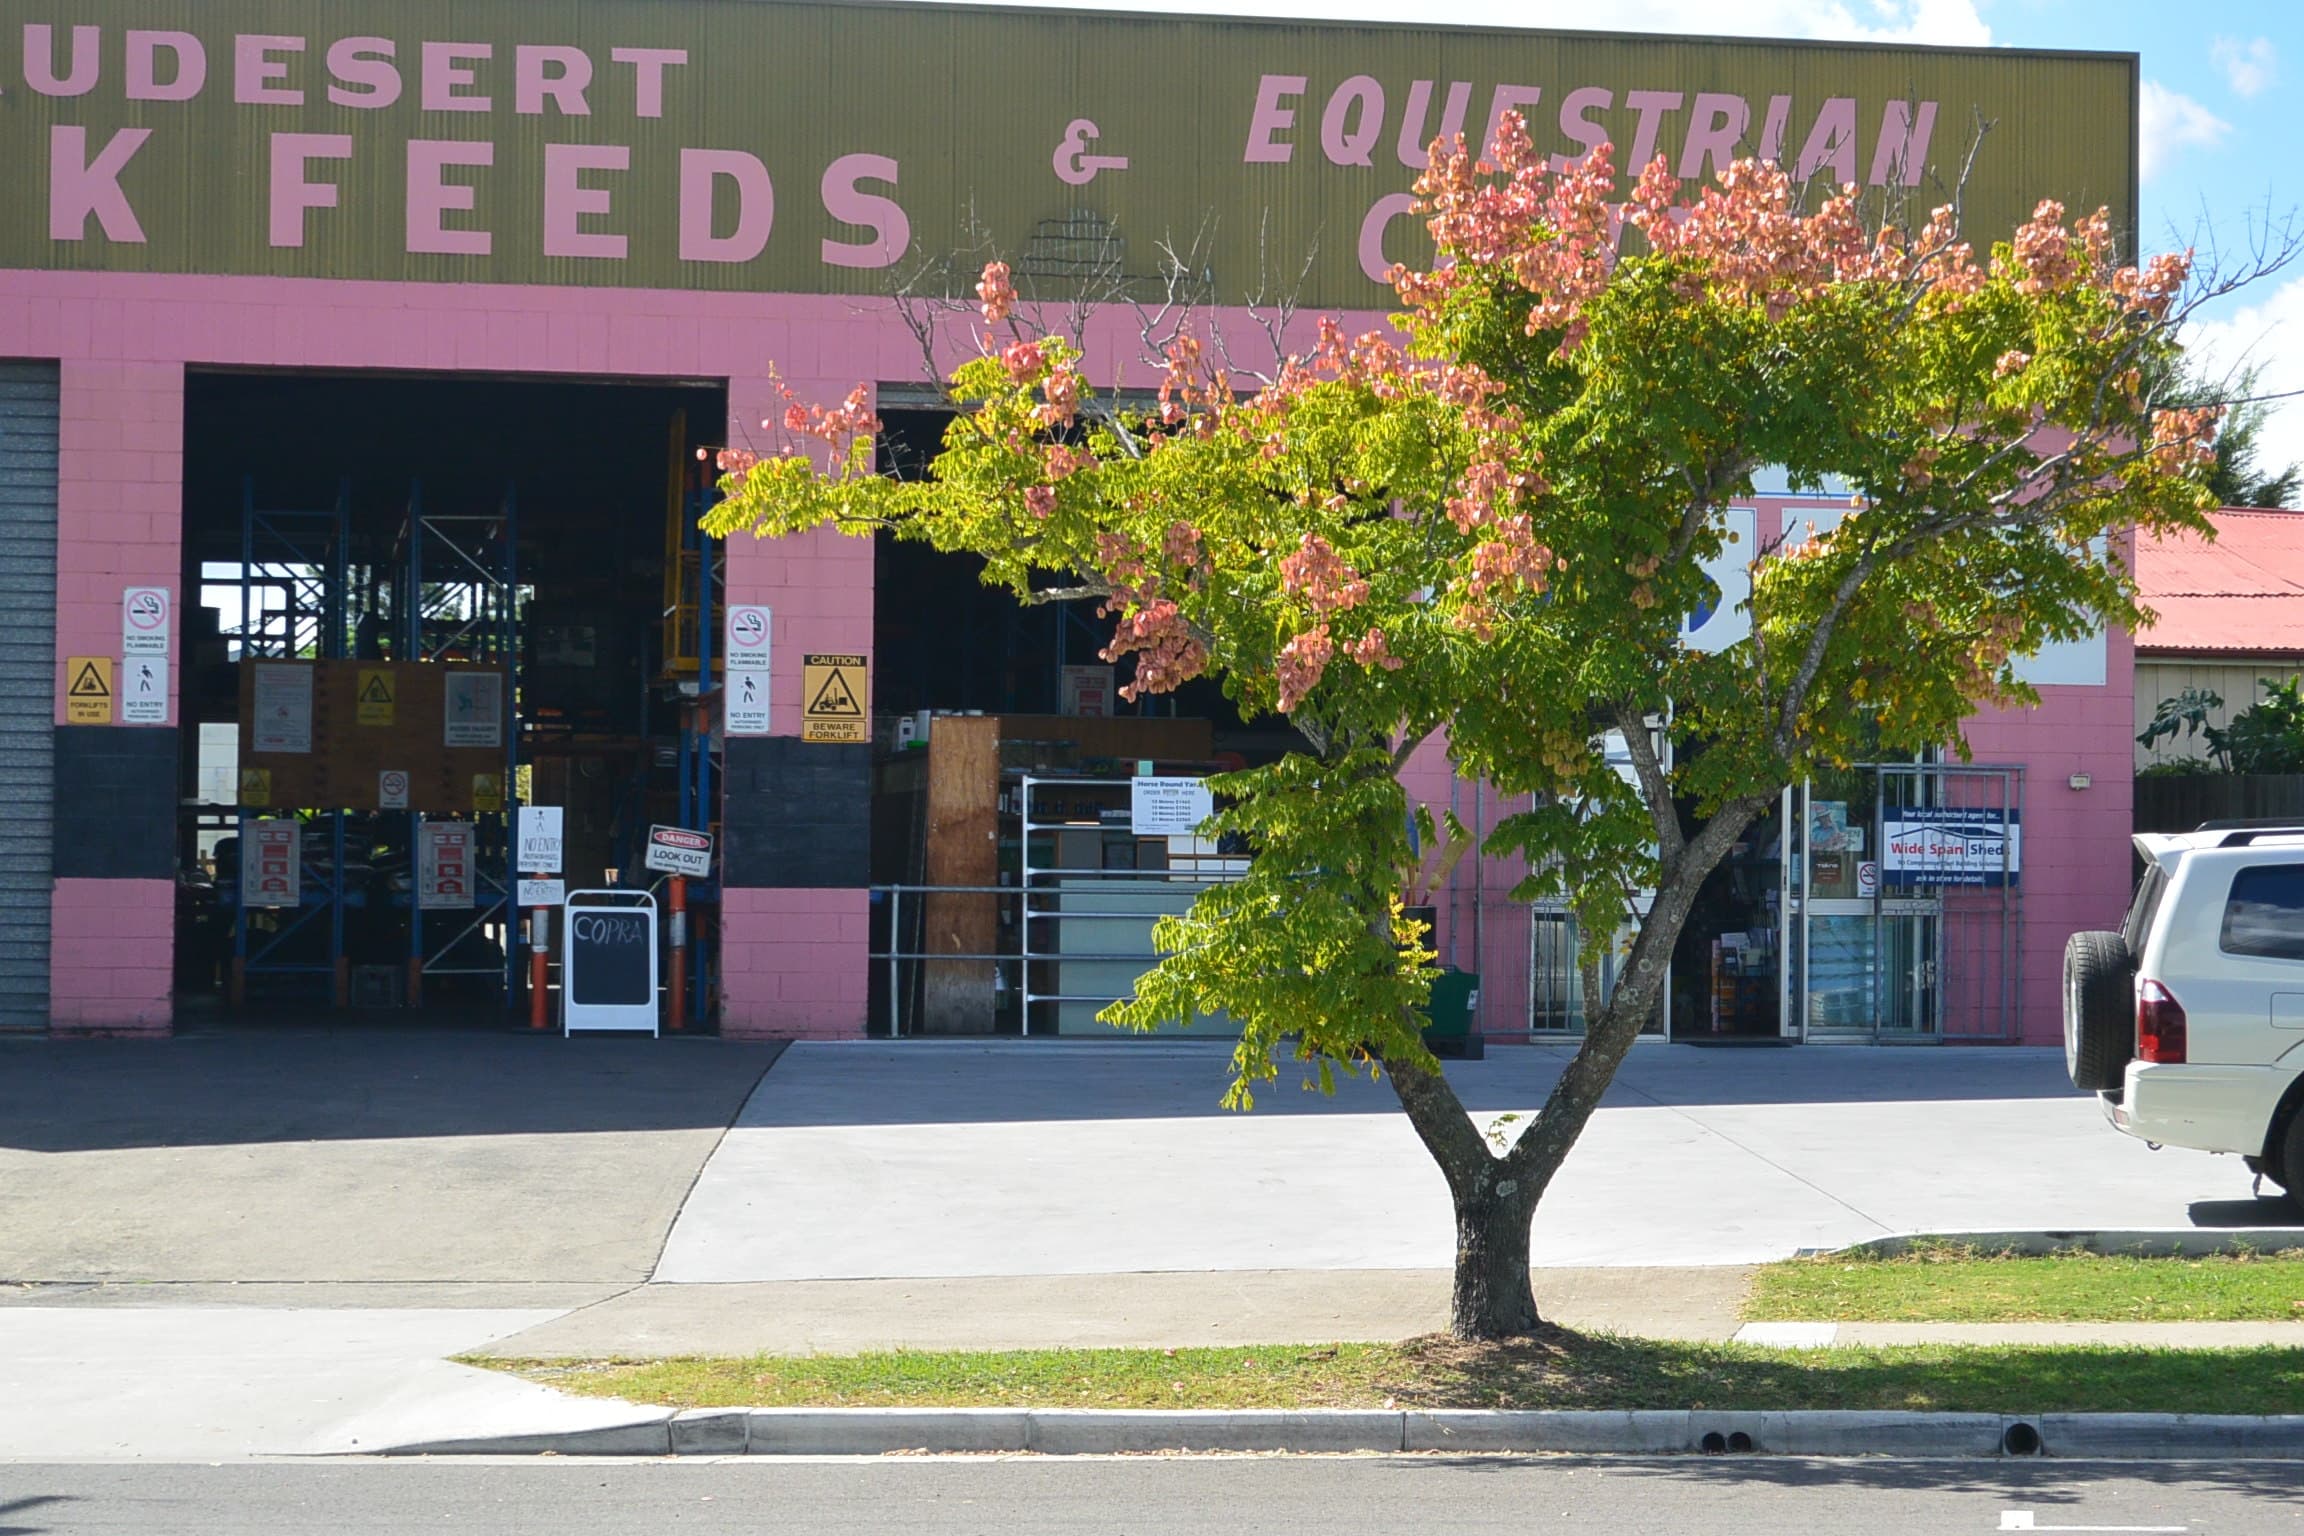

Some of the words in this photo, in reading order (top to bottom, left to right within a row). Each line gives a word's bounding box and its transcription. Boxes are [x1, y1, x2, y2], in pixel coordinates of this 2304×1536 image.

[0, 24, 688, 118] UDESERT
[1052, 118, 1128, 185] &
[269, 132, 911, 269] FEEDS
[810, 656, 861, 665] CAUTION
[813, 723, 856, 731] BEWARE
[809, 731, 859, 739] FORKLIFT
[524, 838, 536, 852] NO
[662, 833, 701, 846] DANGER
[1891, 843, 1925, 854] Wide
[1929, 843, 1964, 857] Span
[1970, 844, 2010, 855] Shed
[654, 850, 681, 861] LOOK
[683, 854, 704, 865] OUT
[574, 916, 644, 945] COPRA
